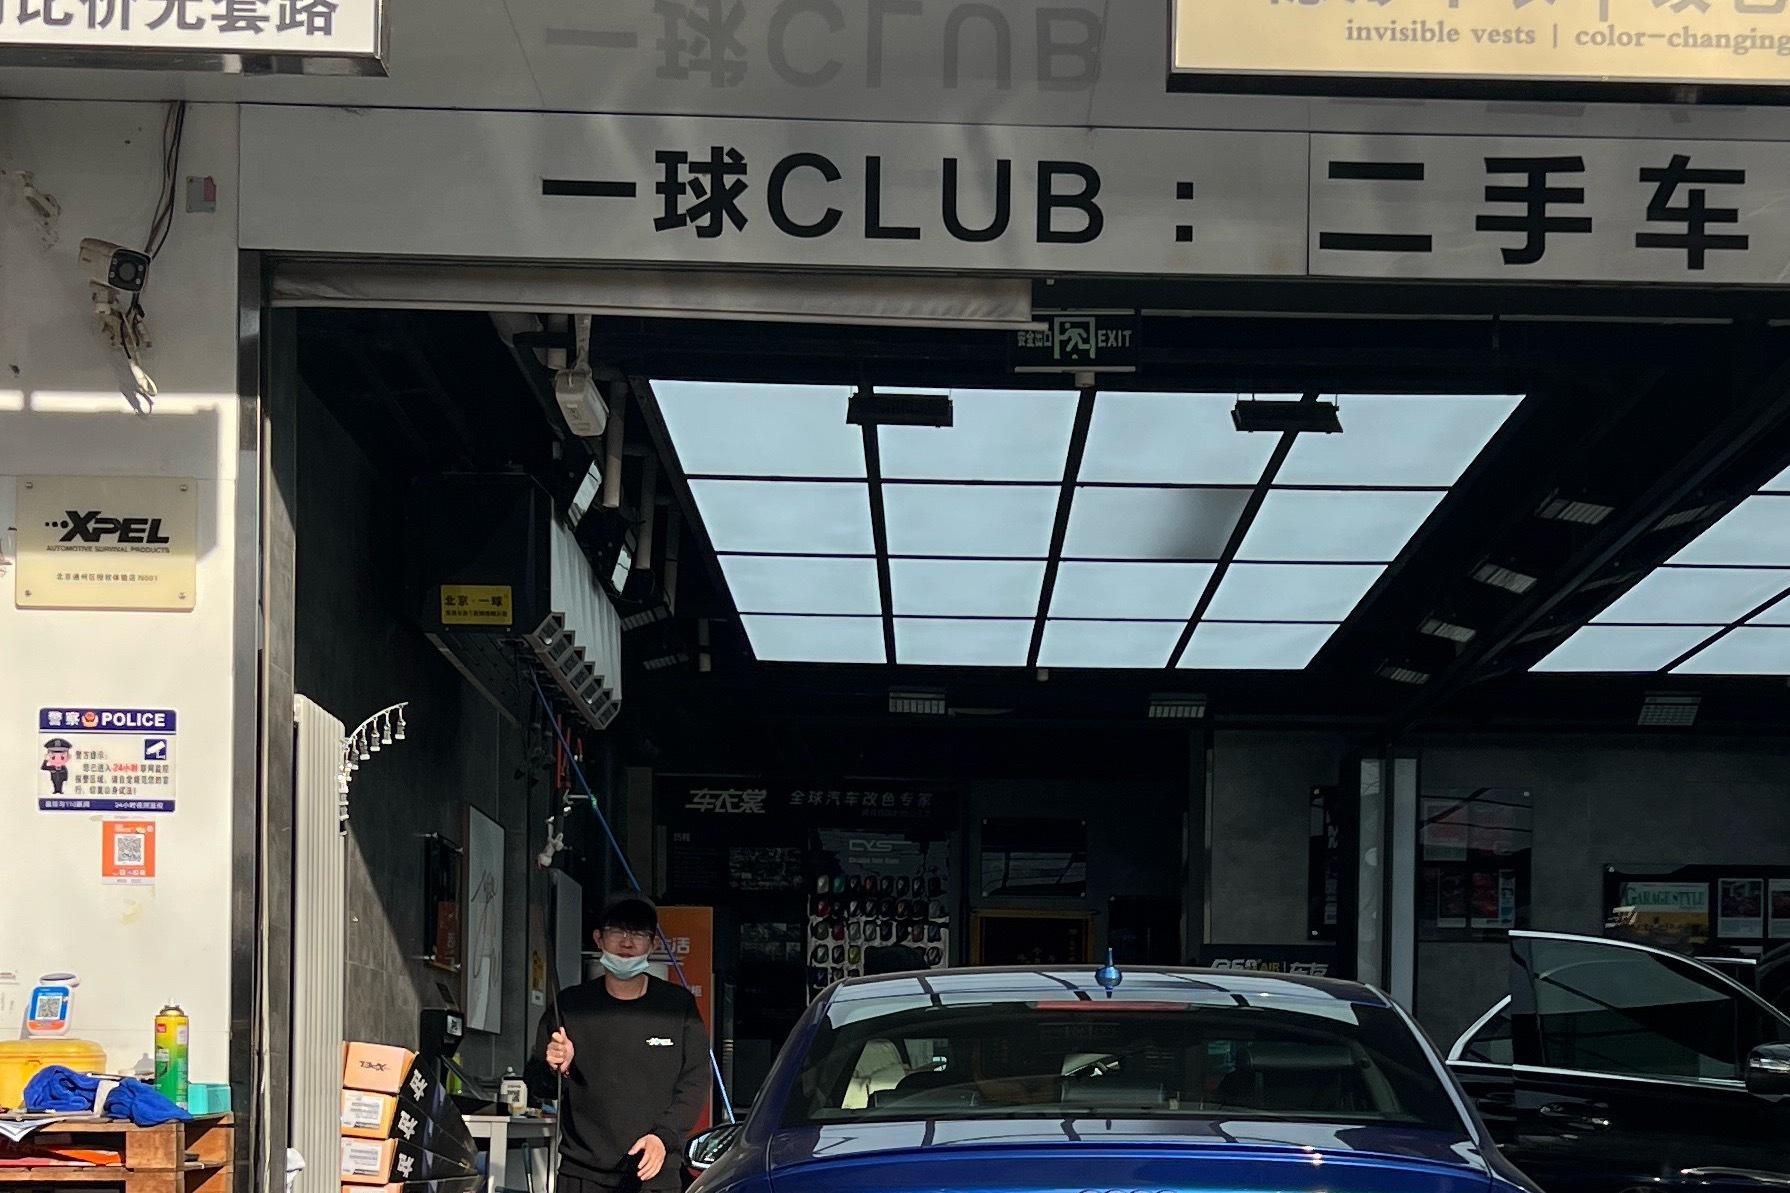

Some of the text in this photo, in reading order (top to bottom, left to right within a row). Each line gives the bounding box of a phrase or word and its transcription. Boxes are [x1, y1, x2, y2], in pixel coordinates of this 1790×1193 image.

[1345, 19, 1460, 44] invisible
[1471, 24, 1537, 46] vests
[1097, 329, 1132, 348] EXIT
[57, 510, 170, 544] XPEL
[48, 711, 166, 727] 警察 POLICE
[685, 787, 768, 814] 车衣裳
